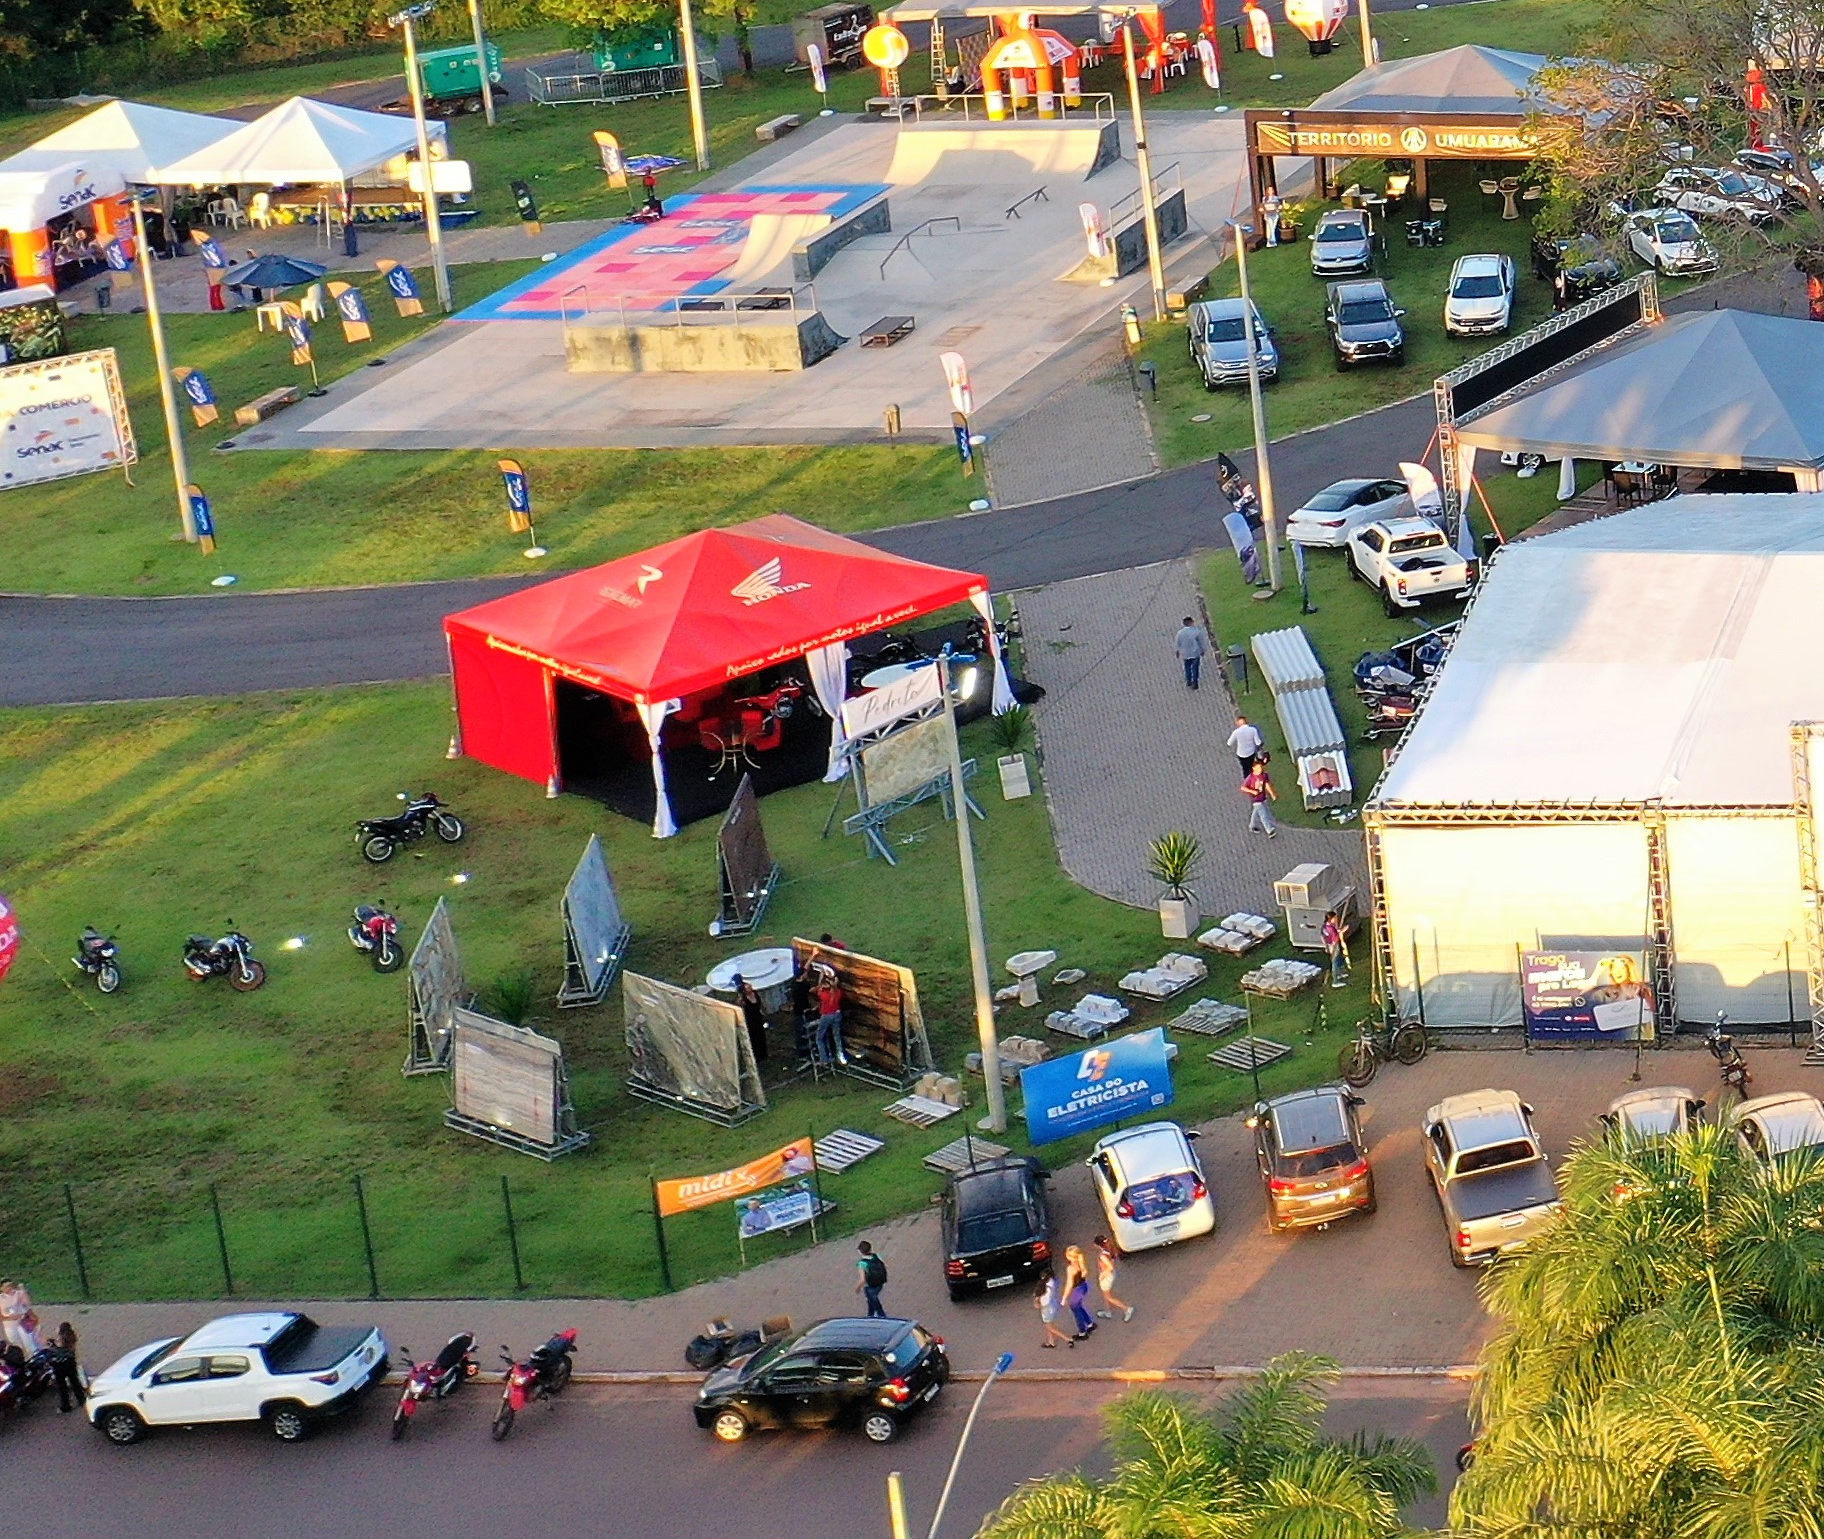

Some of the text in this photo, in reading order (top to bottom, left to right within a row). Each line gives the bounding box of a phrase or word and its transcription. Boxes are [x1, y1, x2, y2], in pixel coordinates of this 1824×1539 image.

[742, 581, 811, 607] HONDA
[1046, 1079, 1149, 1120] ELETRICISTA
[1071, 1077, 1124, 1099] CASA DO
[678, 1169, 749, 1198] midix
